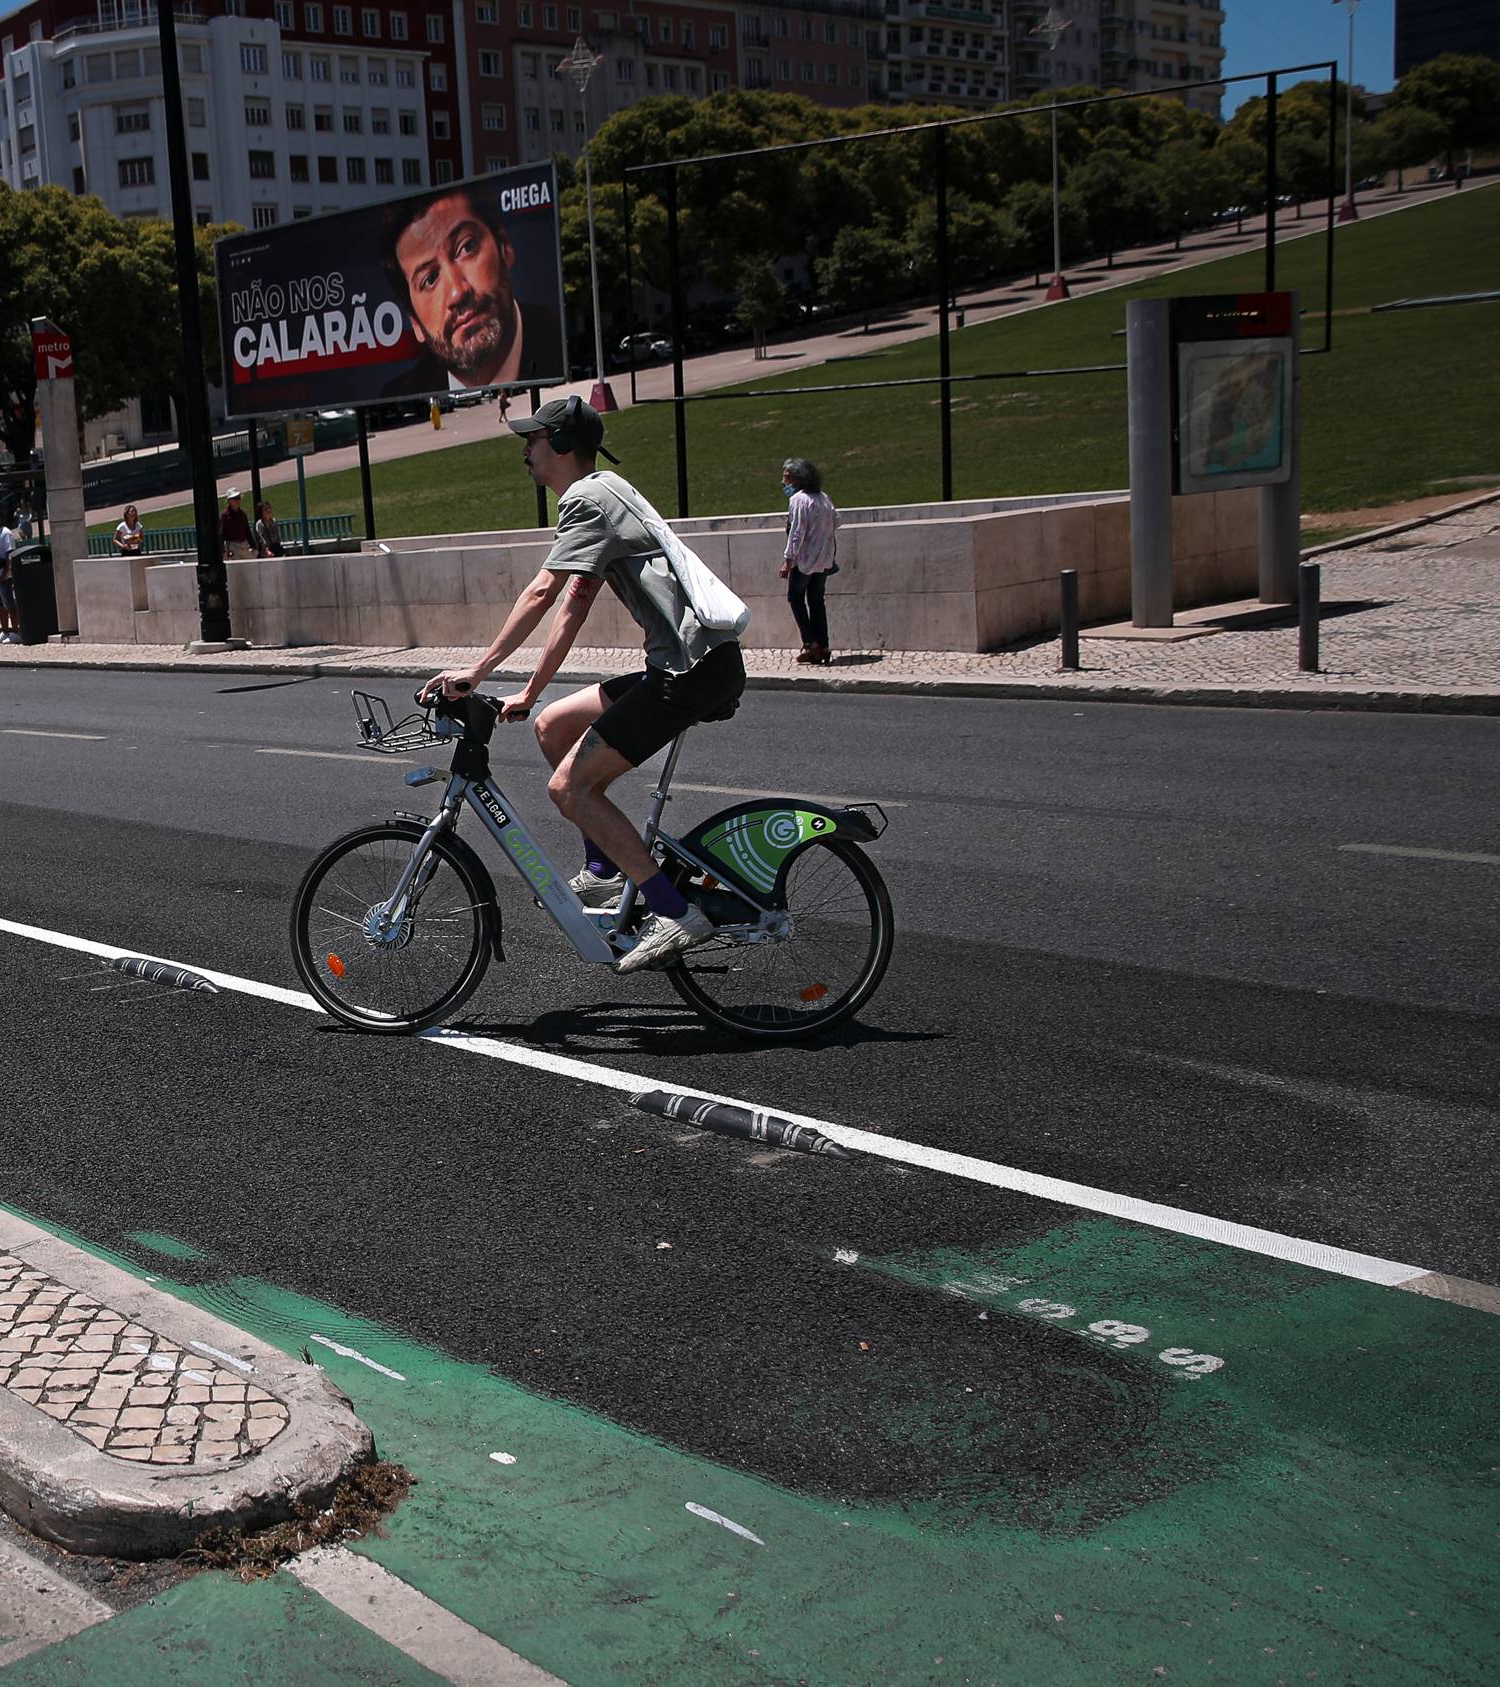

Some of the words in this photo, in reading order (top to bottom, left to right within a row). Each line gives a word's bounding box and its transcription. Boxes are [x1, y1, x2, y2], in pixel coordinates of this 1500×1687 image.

[501, 182, 550, 212] CHEGA
[232, 279, 285, 325] NÃO
[289, 272, 345, 314] NOS
[38, 342, 70, 353] metro
[233, 293, 403, 368] CALARÃO
[479, 790, 490, 801] E
[485, 801, 508, 824] 1648
